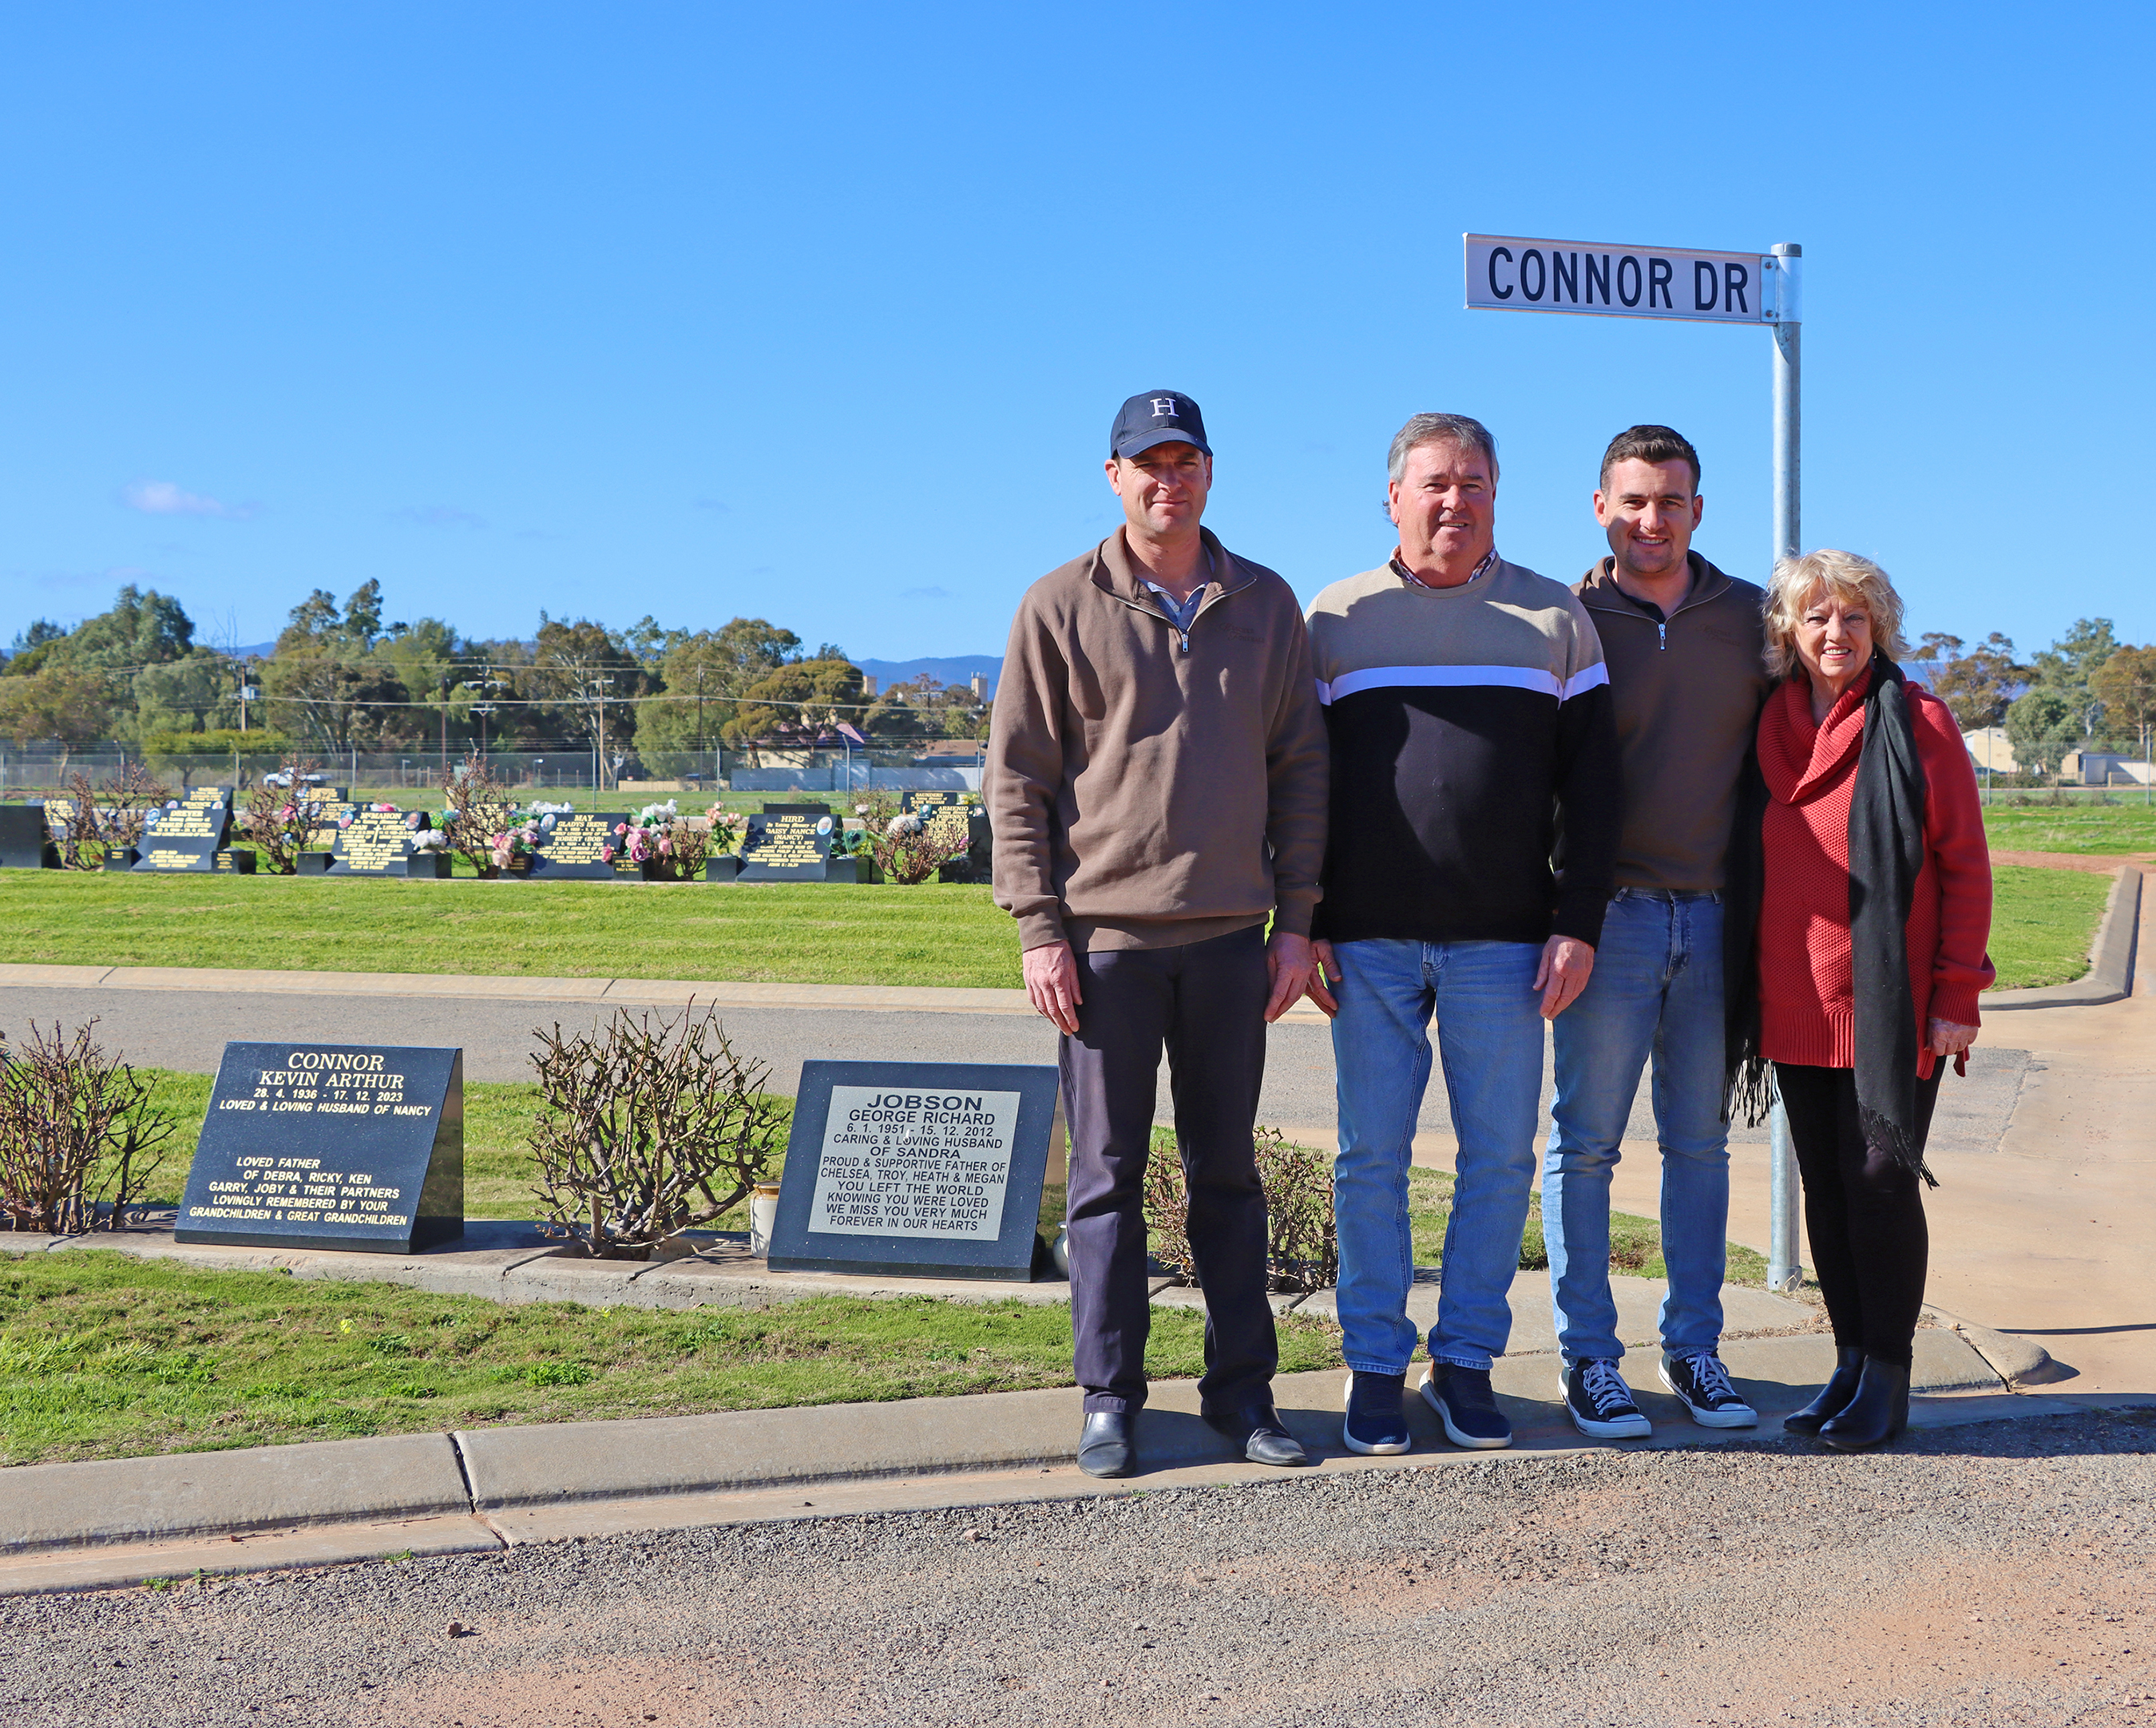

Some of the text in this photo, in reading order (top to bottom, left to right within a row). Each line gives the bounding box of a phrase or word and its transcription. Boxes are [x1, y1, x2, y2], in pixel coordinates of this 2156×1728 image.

[1488, 247, 1748, 313] CONNOR DR
[1150, 398, 1179, 417] H
[288, 1052, 386, 1071] CONNOR
[259, 1071, 404, 1089] KEVIN ARTHUR
[253, 1088, 269, 1098] 28.
[275, 1088, 285, 1098] 4.
[293, 1088, 318, 1099] 1936
[334, 1090, 348, 1100] 17.
[356, 1091, 371, 1101] 12.
[376, 1092, 403, 1102] 2023
[867, 1094, 982, 1111] JOBSON
[219, 1100, 432, 1116] LOVED & LOVING HUSBAND OF NANCY
[849, 1109, 995, 1125] GEORGE RICHARD
[847, 1123, 856, 1132] 6.
[863, 1124, 871, 1133] 1.
[878, 1124, 904, 1134] 1951
[921, 1125, 936, 1135] 15.
[943, 1126, 958, 1135] 12.
[965, 1126, 993, 1137] 2012
[834, 1134, 1002, 1148] CARING & LOVING HUSBAND
[870, 1147, 961, 1159] OF SANDRA
[236, 1156, 321, 1169] LOVED FATHER
[822, 1156, 1006, 1171] PROUD & SUPPORTIVE FATHER OF
[244, 1170, 372, 1184] OF DEBRA, RICKY, KEN
[821, 1167, 1005, 1184] CHELSEA, TROY, HEATH & MEGAN
[208, 1181, 400, 1199] GARRY, JOBY & THEIR PARTNERS
[838, 1181, 984, 1195] YOU LEFT THE WORLD
[212, 1195, 388, 1211] LOVINGLY REMEMBERED BY YOUR
[827, 1192, 989, 1207] KNOWING YOU WERE LOVED
[189, 1207, 407, 1226] GRANDCHILDREN & GREAT GRANDCHILDREN
[826, 1203, 987, 1219] WE MISS YOU VERY MUCH
[830, 1215, 977, 1231] FOREVER IN OUR HEARTS
